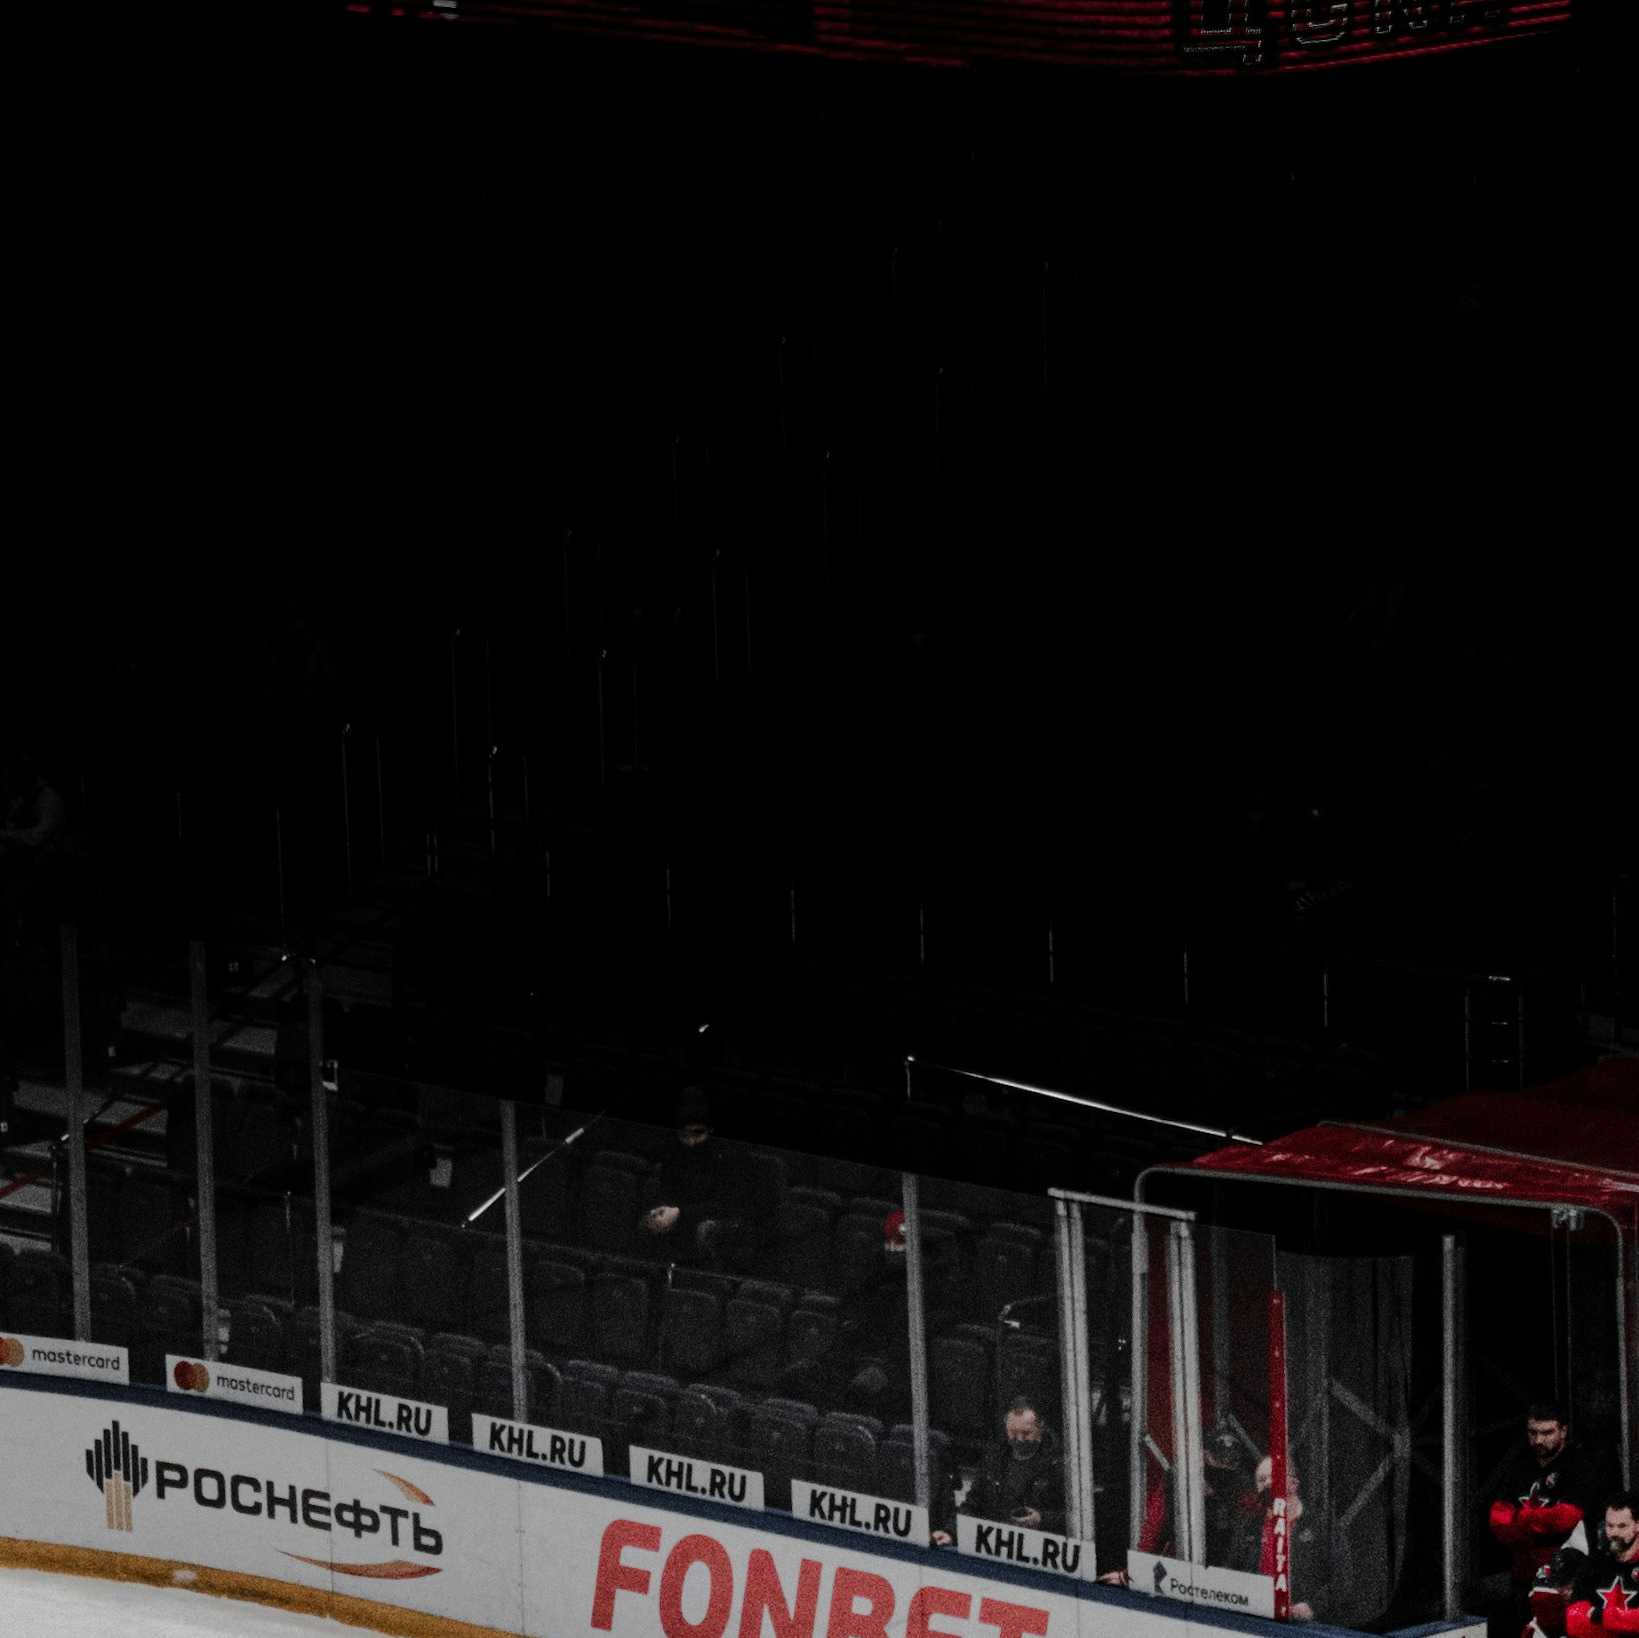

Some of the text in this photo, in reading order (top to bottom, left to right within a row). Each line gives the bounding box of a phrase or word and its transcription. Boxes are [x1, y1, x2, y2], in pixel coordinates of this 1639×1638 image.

[31, 1344, 121, 1371] mastercard
[216, 1370, 296, 1402] mastercard
[336, 1391, 434, 1438] KHL.RU
[488, 1422, 587, 1469] KHL.RU
[646, 1455, 748, 1503] KHL.RU
[155, 1461, 444, 1556] РОСНЕФТЬ
[808, 1489, 913, 1538] KHL.RU
[974, 1523, 1081, 1575] KHL.RU
[1273, 1497, 1289, 1593] RAITA
[1169, 1577, 1250, 1608] Ростелеком
